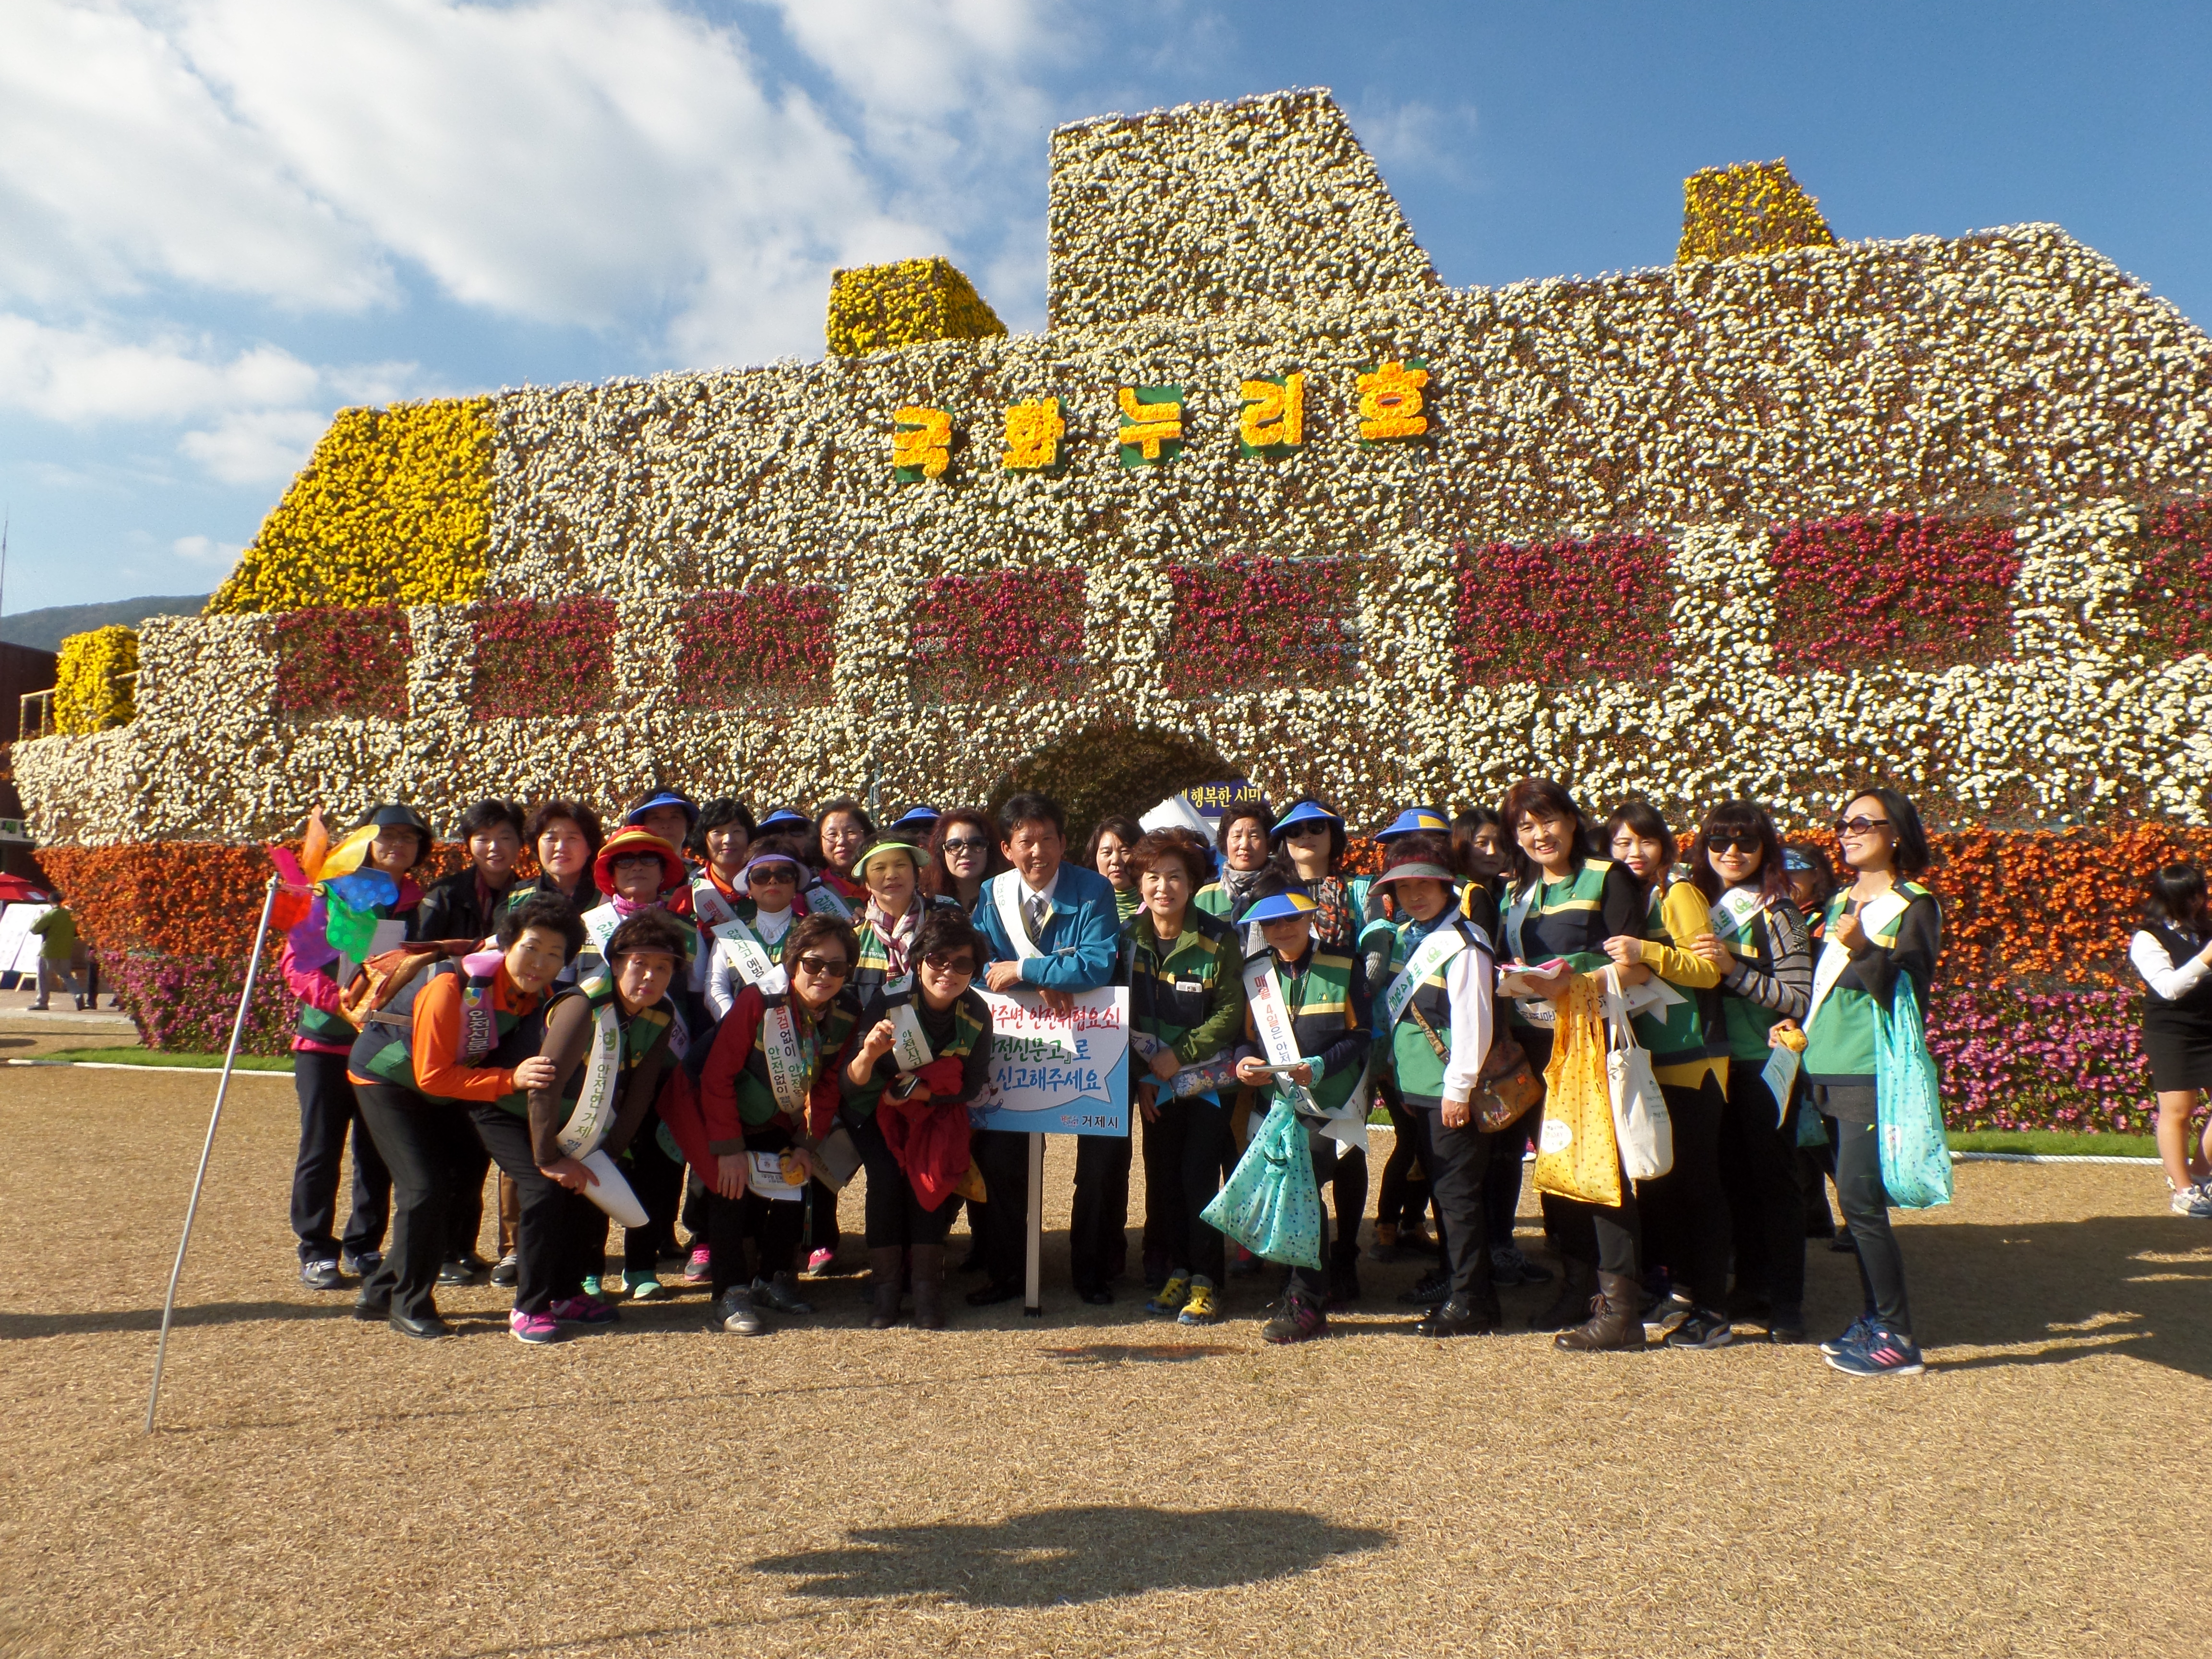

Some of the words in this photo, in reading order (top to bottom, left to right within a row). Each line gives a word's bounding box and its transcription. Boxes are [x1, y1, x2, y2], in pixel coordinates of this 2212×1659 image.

[893, 361, 1429, 479] 국화누리호
[1190, 786, 1232, 808] 행복한
[727, 928, 753, 959] 안전사고
[746, 957, 765, 979] 예방
[1254, 974, 1272, 1000] 매월
[902, 1029, 923, 1067] 안전사고
[768, 1045, 788, 1094] 안전없이
[996, 1066, 1102, 1093] 신고해주세요
[589, 1064, 611, 1108] 안전한
[574, 1112, 598, 1139] 거제
[1082, 1115, 1118, 1129] 거제시
